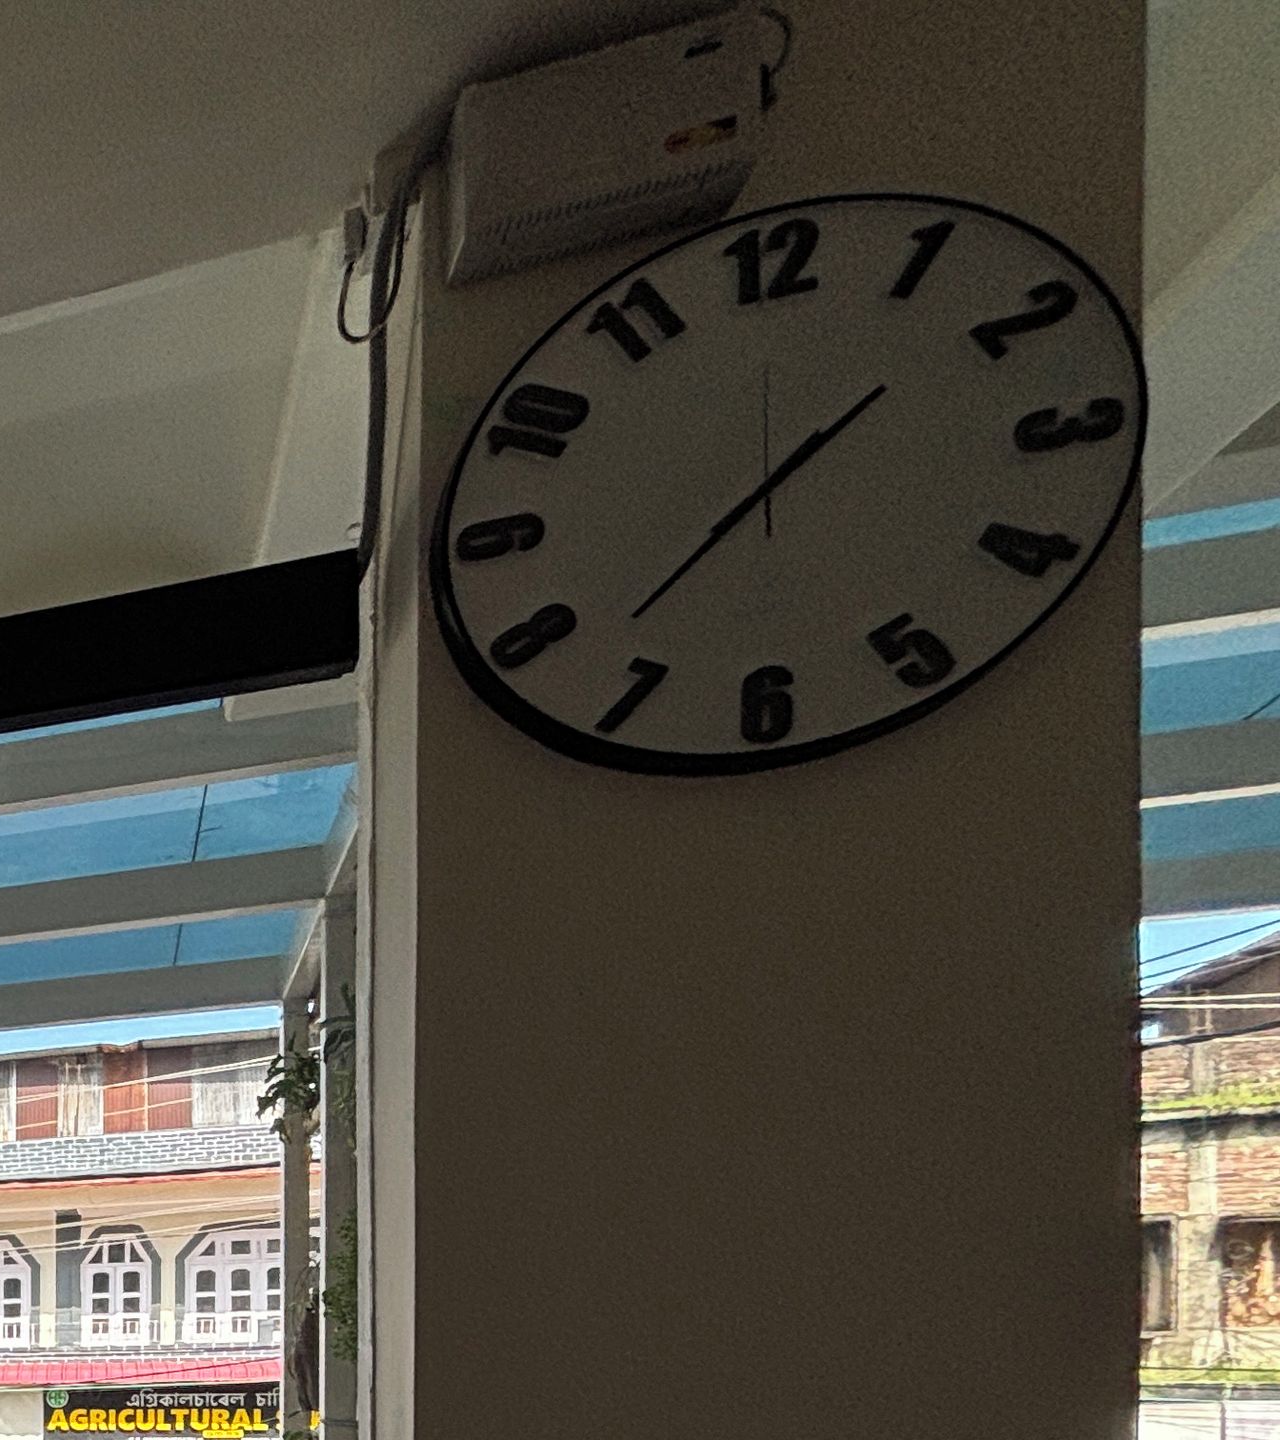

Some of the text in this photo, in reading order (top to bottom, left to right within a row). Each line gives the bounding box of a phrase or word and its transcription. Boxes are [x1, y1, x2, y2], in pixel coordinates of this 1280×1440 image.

[723, 218, 820, 305] 12
[889, 220, 956, 299] 1
[586, 277, 687, 363] 11
[969, 279, 1077, 361] 2
[487, 382, 590, 459] 10
[1013, 397, 1125, 453] 3
[456, 512, 546, 562] 9
[978, 521, 1081, 578] 4
[490, 602, 577, 669] 8
[867, 611, 957, 689] 5
[594, 657, 670, 735] 7
[739, 664, 795, 744] 6
[47, 1409, 270, 1431] AGRICULTURAL
